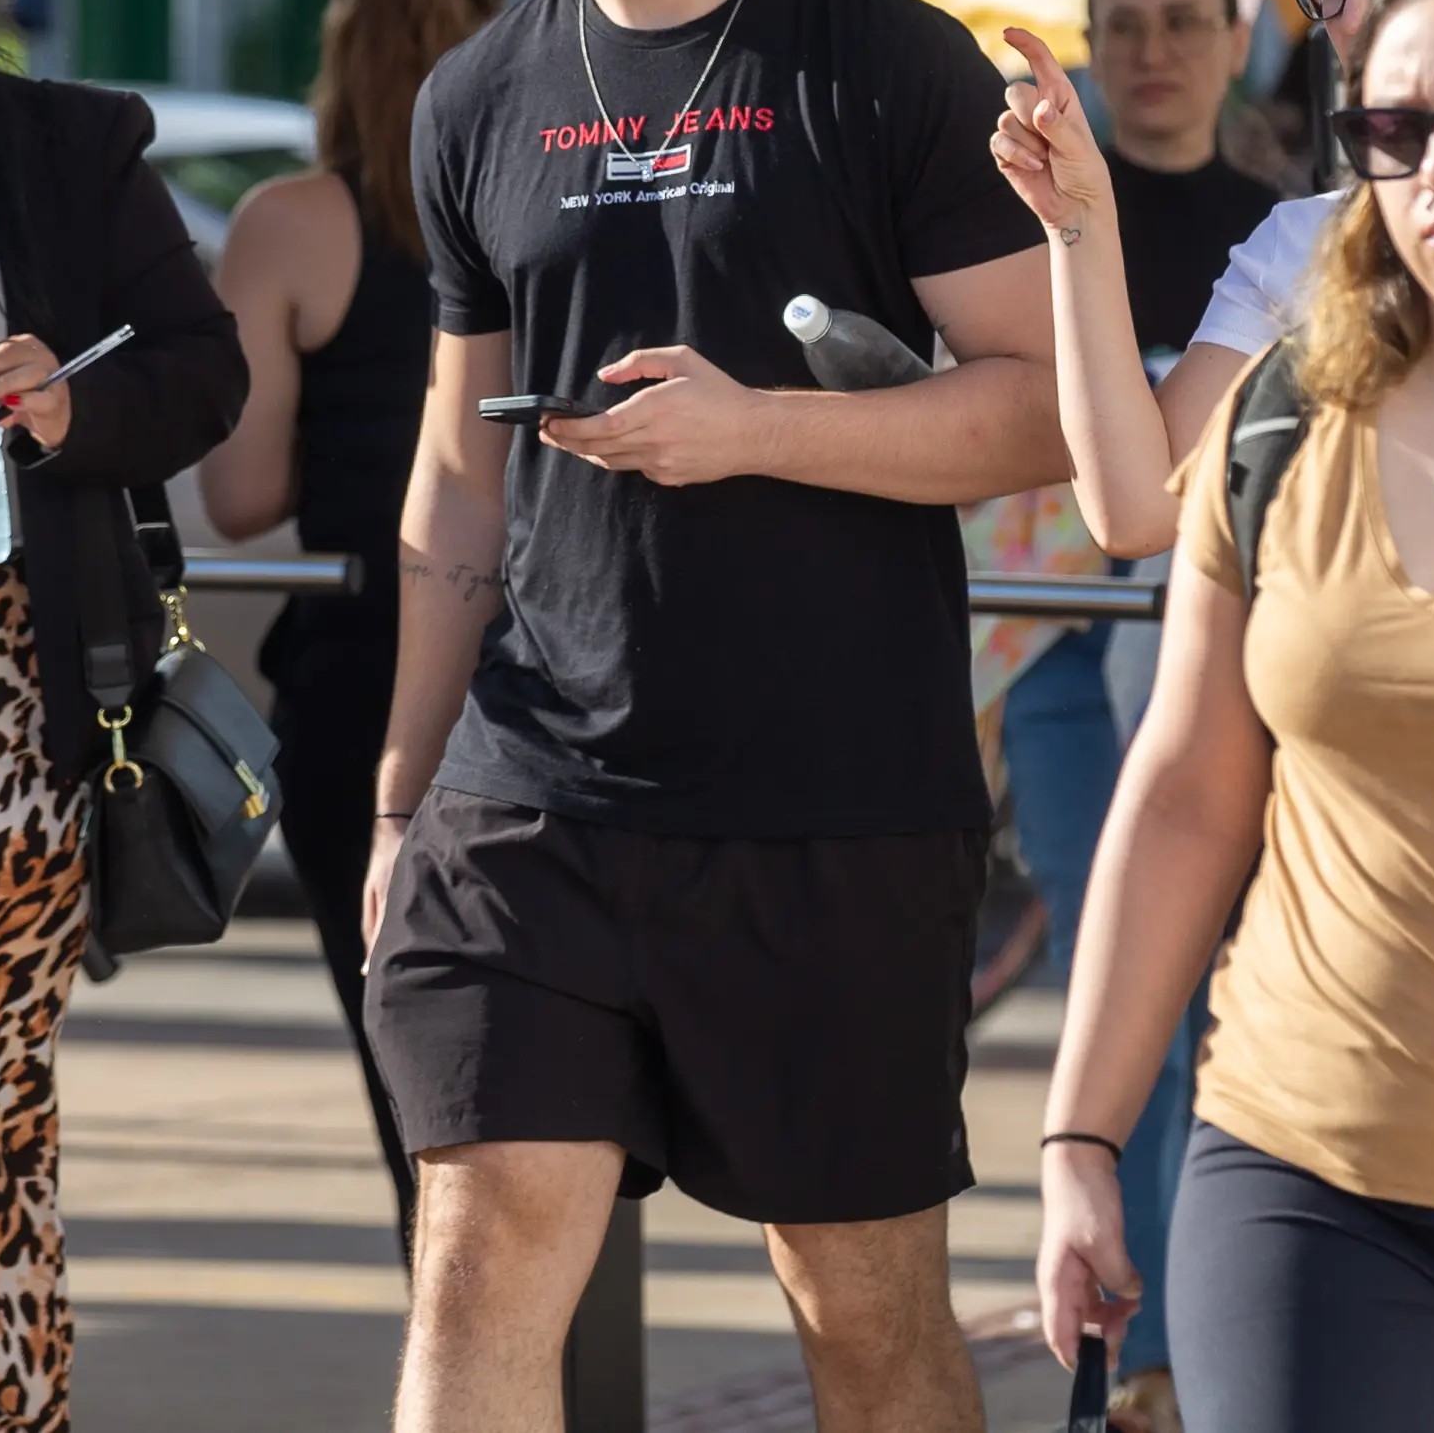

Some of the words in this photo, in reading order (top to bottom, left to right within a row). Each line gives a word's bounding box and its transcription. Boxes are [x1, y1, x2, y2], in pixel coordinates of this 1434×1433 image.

[539, 115, 647, 153] TOMMY
[664, 105, 775, 138] JEANS
[560, 193, 589, 210] NEW
[594, 190, 632, 206] YORK
[635, 183, 687, 203] American
[689, 179, 735, 198] Original
